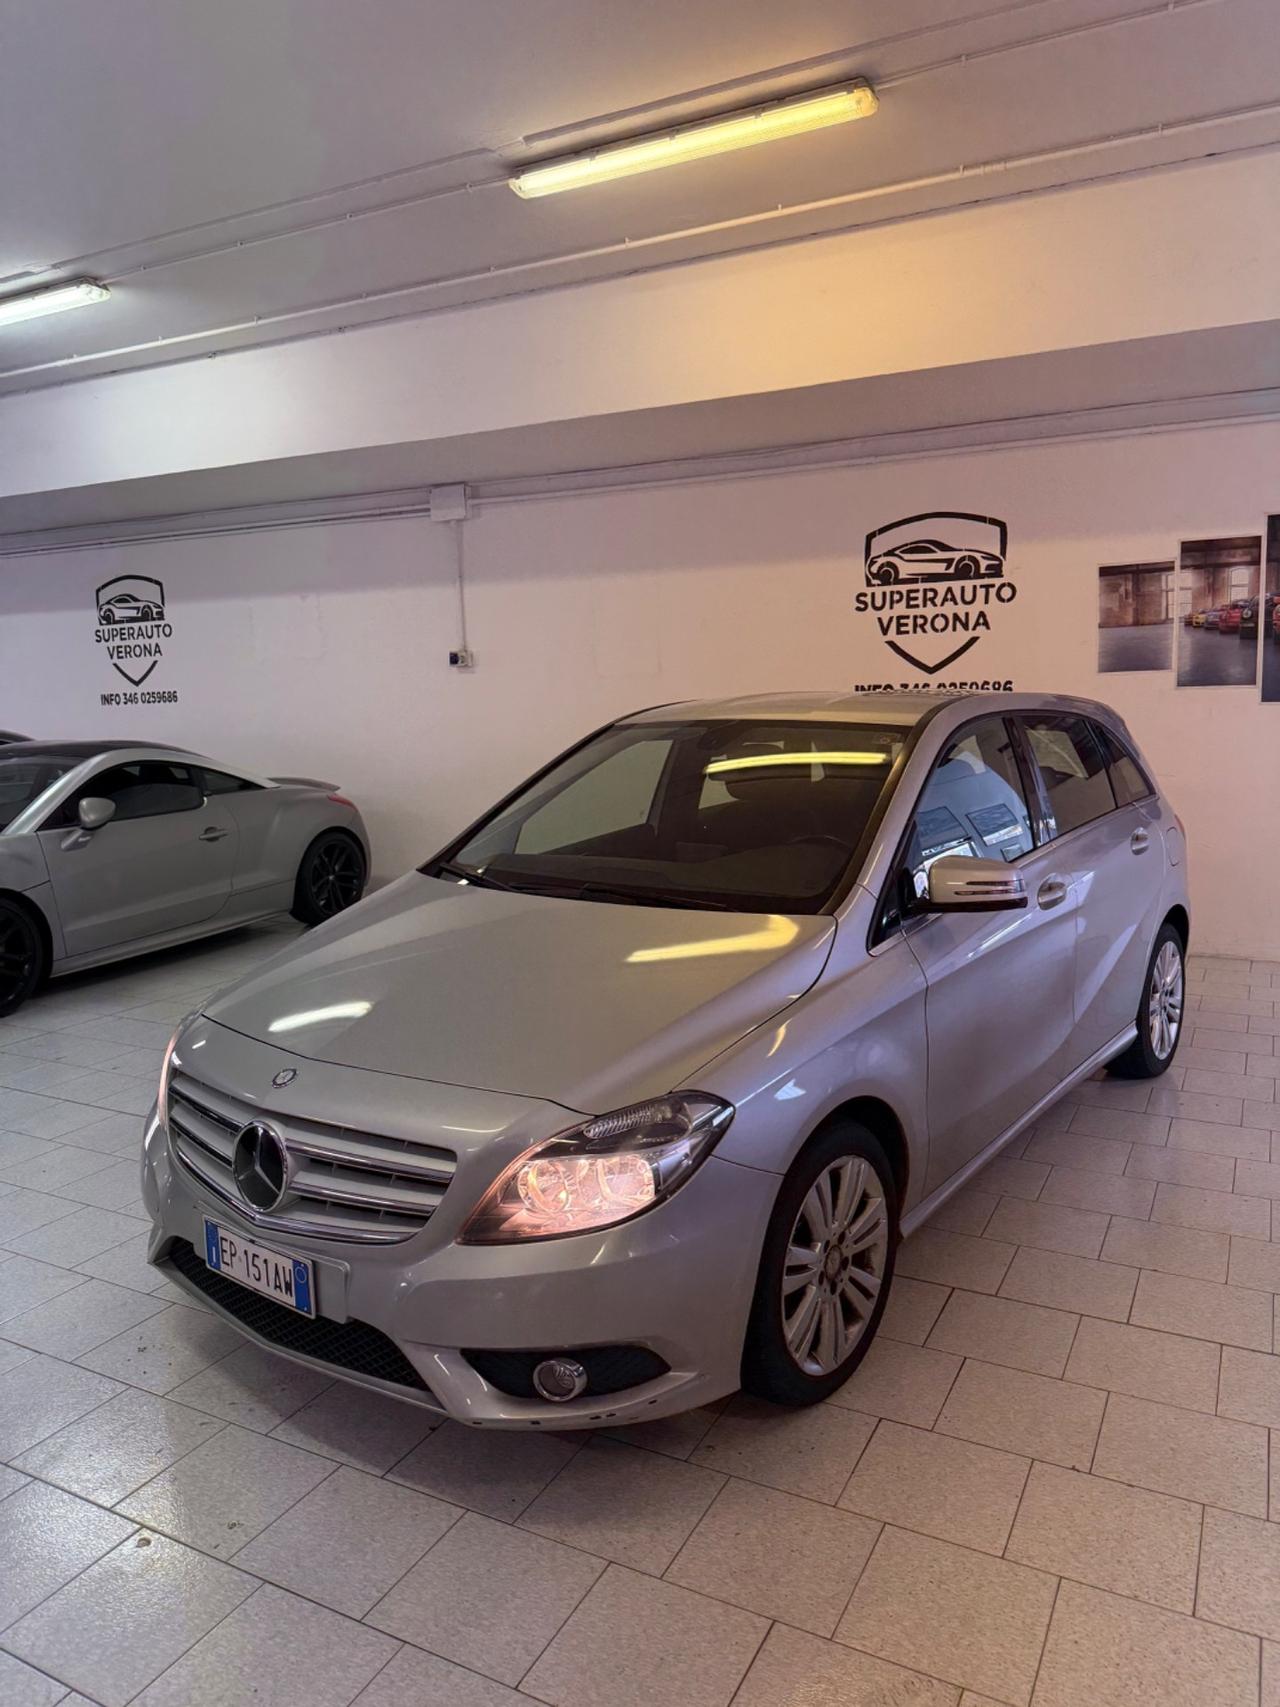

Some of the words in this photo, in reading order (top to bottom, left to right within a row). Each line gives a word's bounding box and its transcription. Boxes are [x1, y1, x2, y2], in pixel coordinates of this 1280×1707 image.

[854, 582, 1017, 612] SUPERAUTO
[94, 623, 173, 643] SUPERAUTO
[877, 610, 991, 636] VERONA
[106, 643, 163, 660] VERONA
[100, 693, 121, 706] INFO
[122, 692, 139, 705] 346
[140, 690, 178, 704] 0259686
[220, 1236, 238, 1269] EP
[243, 1249, 294, 1297] 151AW
